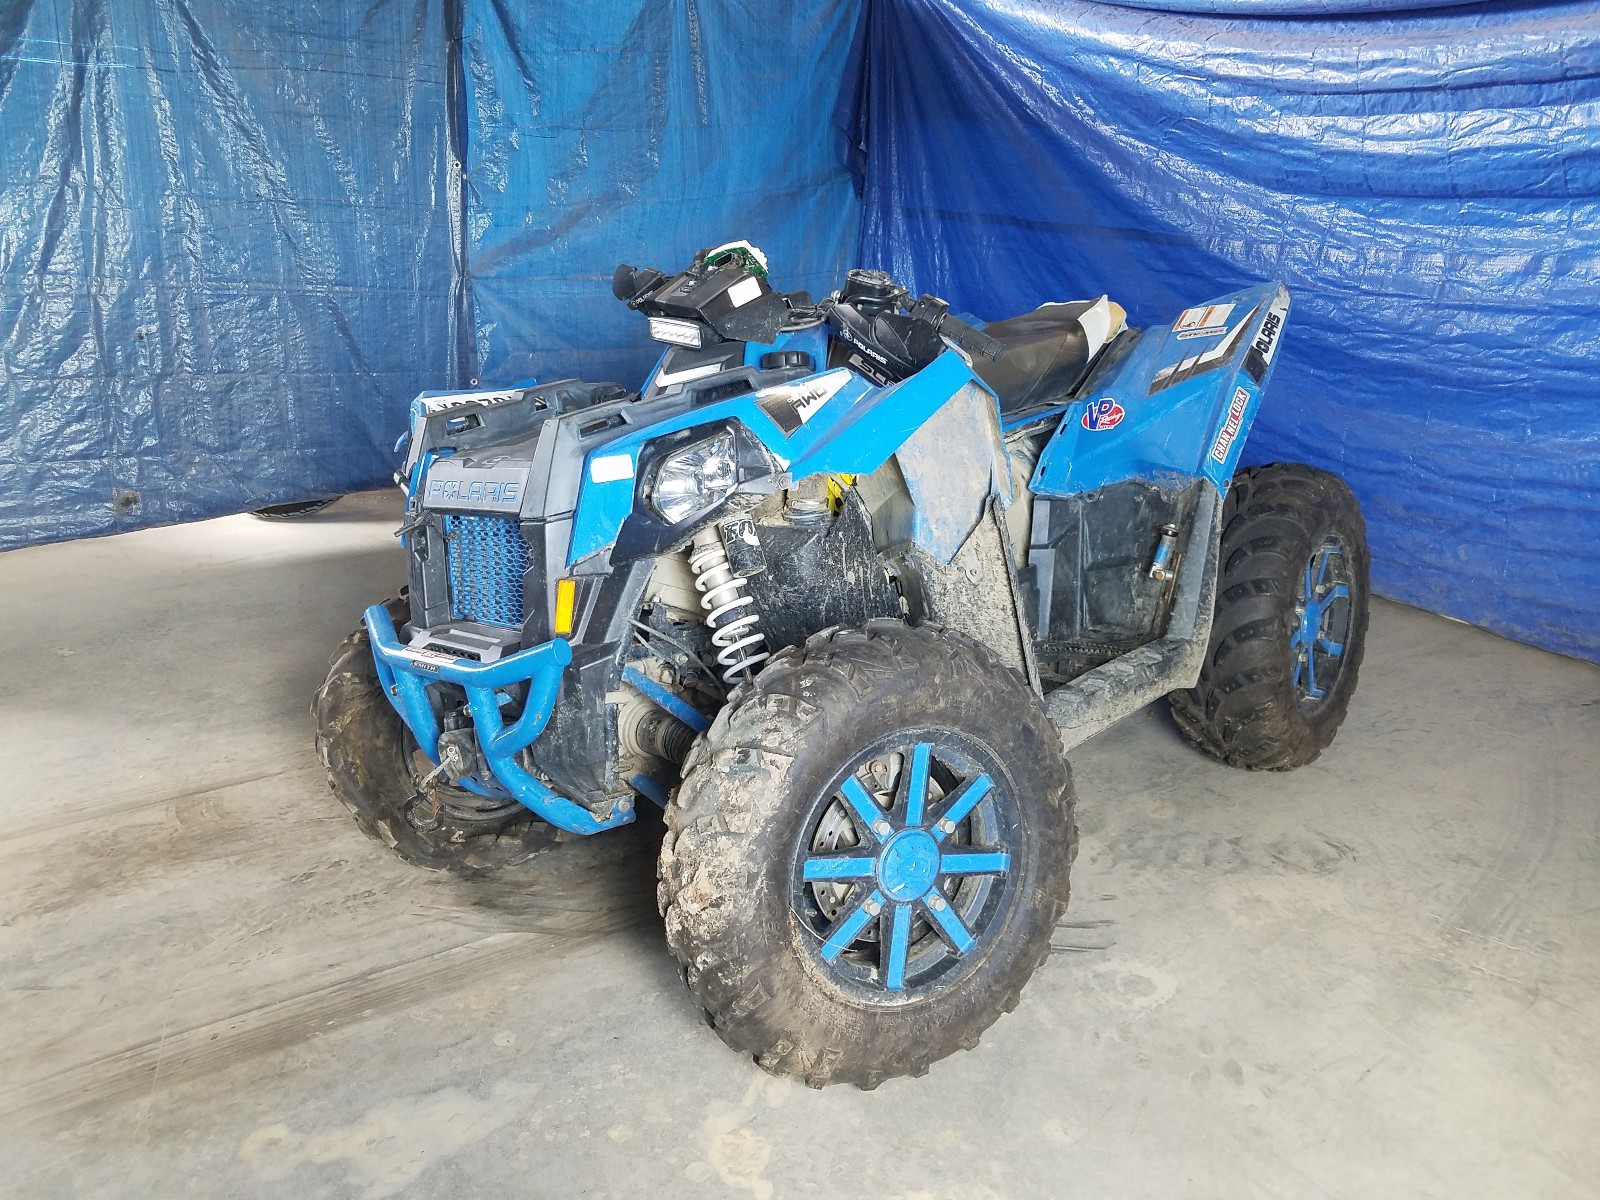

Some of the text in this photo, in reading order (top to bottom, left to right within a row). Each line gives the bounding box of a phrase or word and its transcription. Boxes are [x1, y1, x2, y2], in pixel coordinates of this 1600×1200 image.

[853, 338, 888, 364] POLARIS
[790, 386, 828, 415] AWD
[1087, 399, 1115, 430] VP
[429, 480, 520, 503] POLARIS
